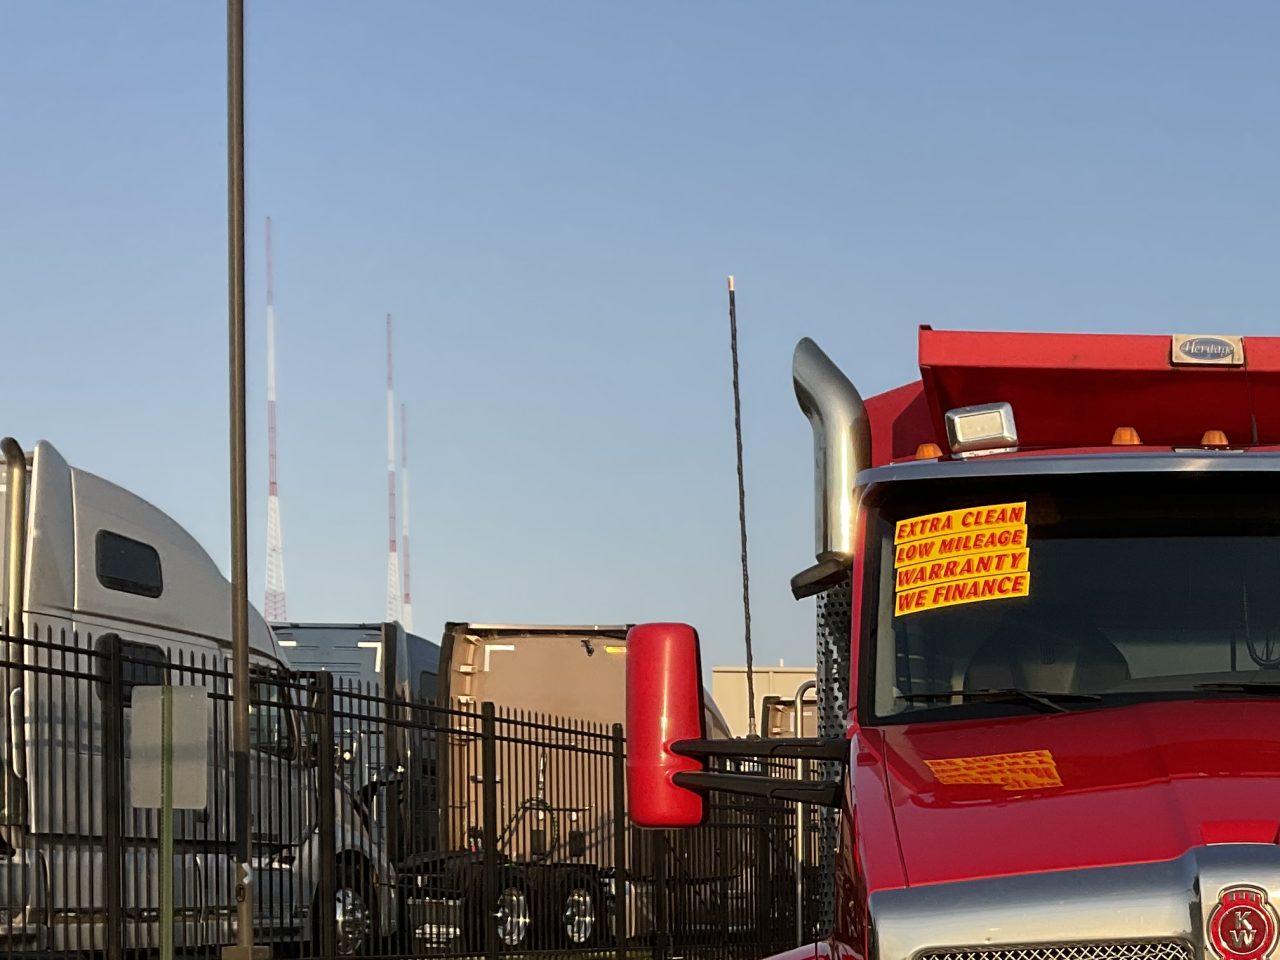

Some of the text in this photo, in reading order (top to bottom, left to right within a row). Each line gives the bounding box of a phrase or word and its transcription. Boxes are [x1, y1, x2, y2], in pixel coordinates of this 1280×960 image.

[897, 506, 1024, 540] EXTRA CLEAN
[896, 529, 1025, 563] LOW MILEAGE
[897, 552, 1026, 587] WARRANTY
[897, 576, 1026, 612] WE FINANCE
